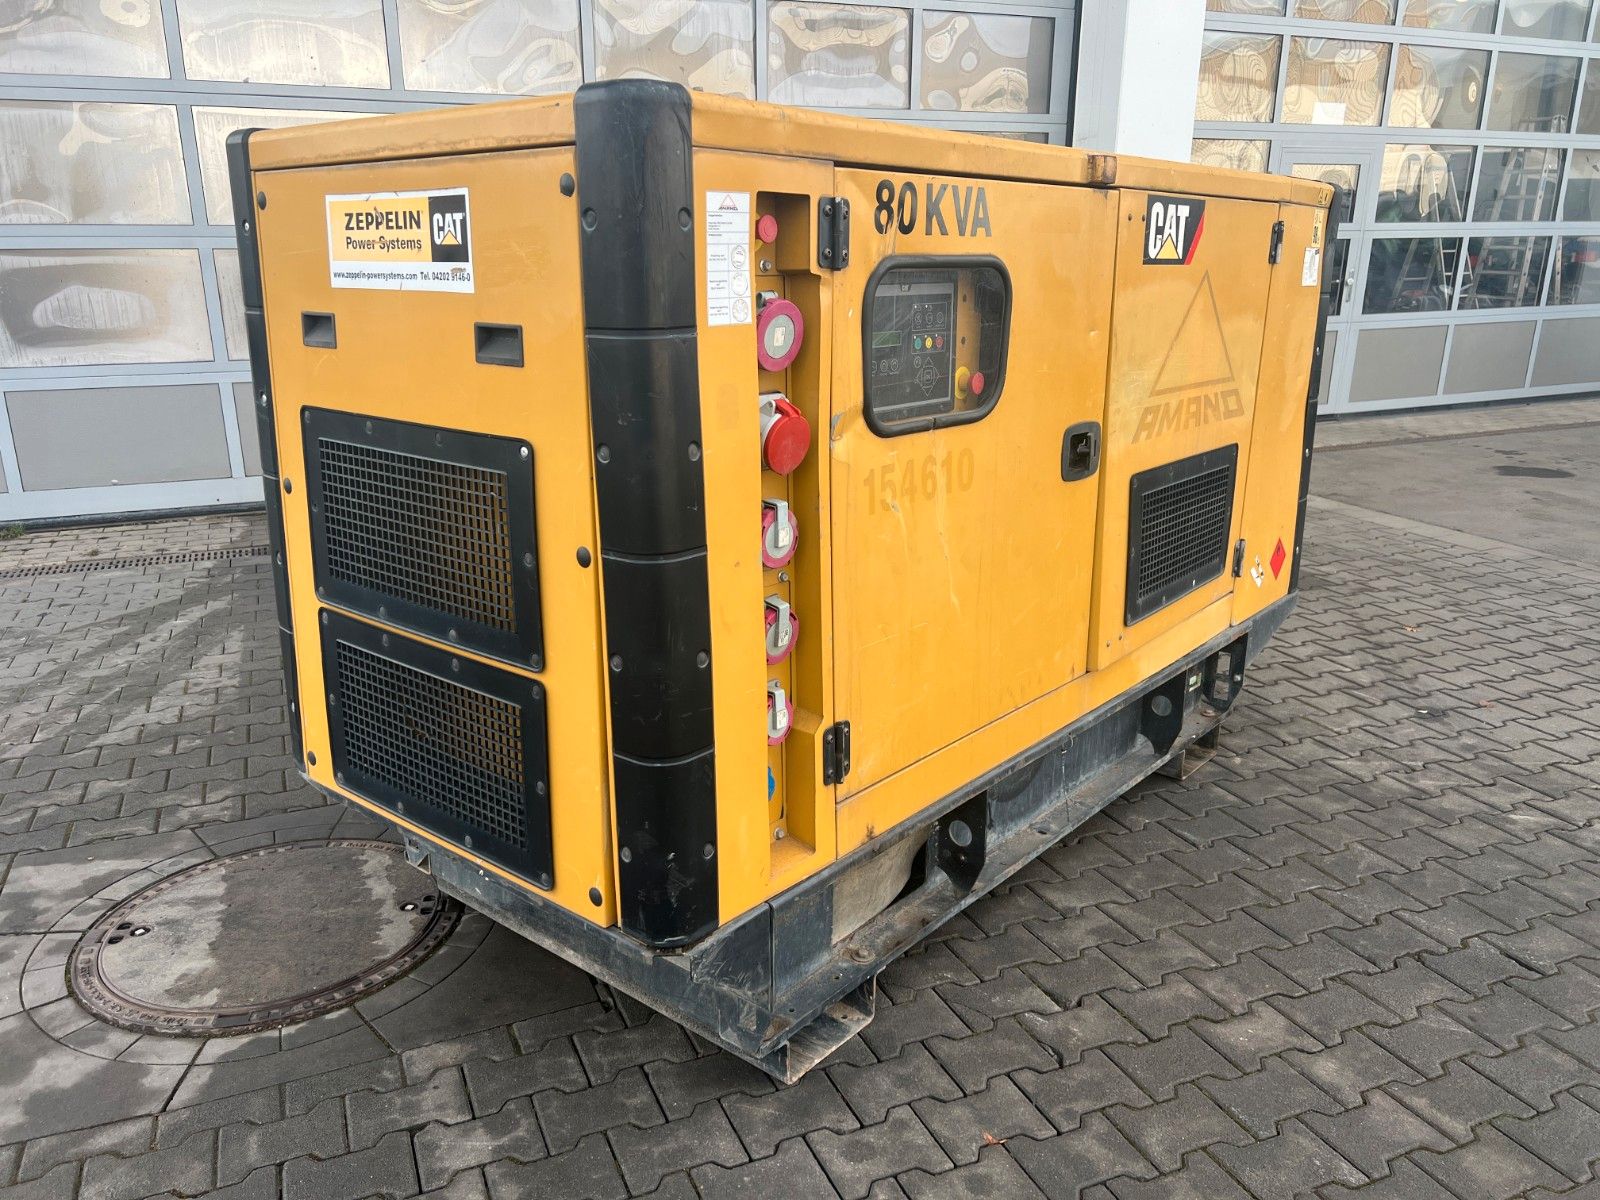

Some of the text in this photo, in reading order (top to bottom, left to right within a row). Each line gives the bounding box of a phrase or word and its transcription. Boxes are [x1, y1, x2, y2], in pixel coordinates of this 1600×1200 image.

[344, 209, 422, 231] ZEPPELIN
[874, 179, 992, 237] 80 KVA
[346, 235, 422, 252] Power Systems
[432, 212, 463, 246] CAT
[1148, 201, 1190, 260] CAT
[333, 270, 418, 281] www.zeppelin-powersystems.com
[420, 271, 431, 281] Tel.
[432, 271, 450, 281] 04202
[863, 447, 975, 515] 154610
